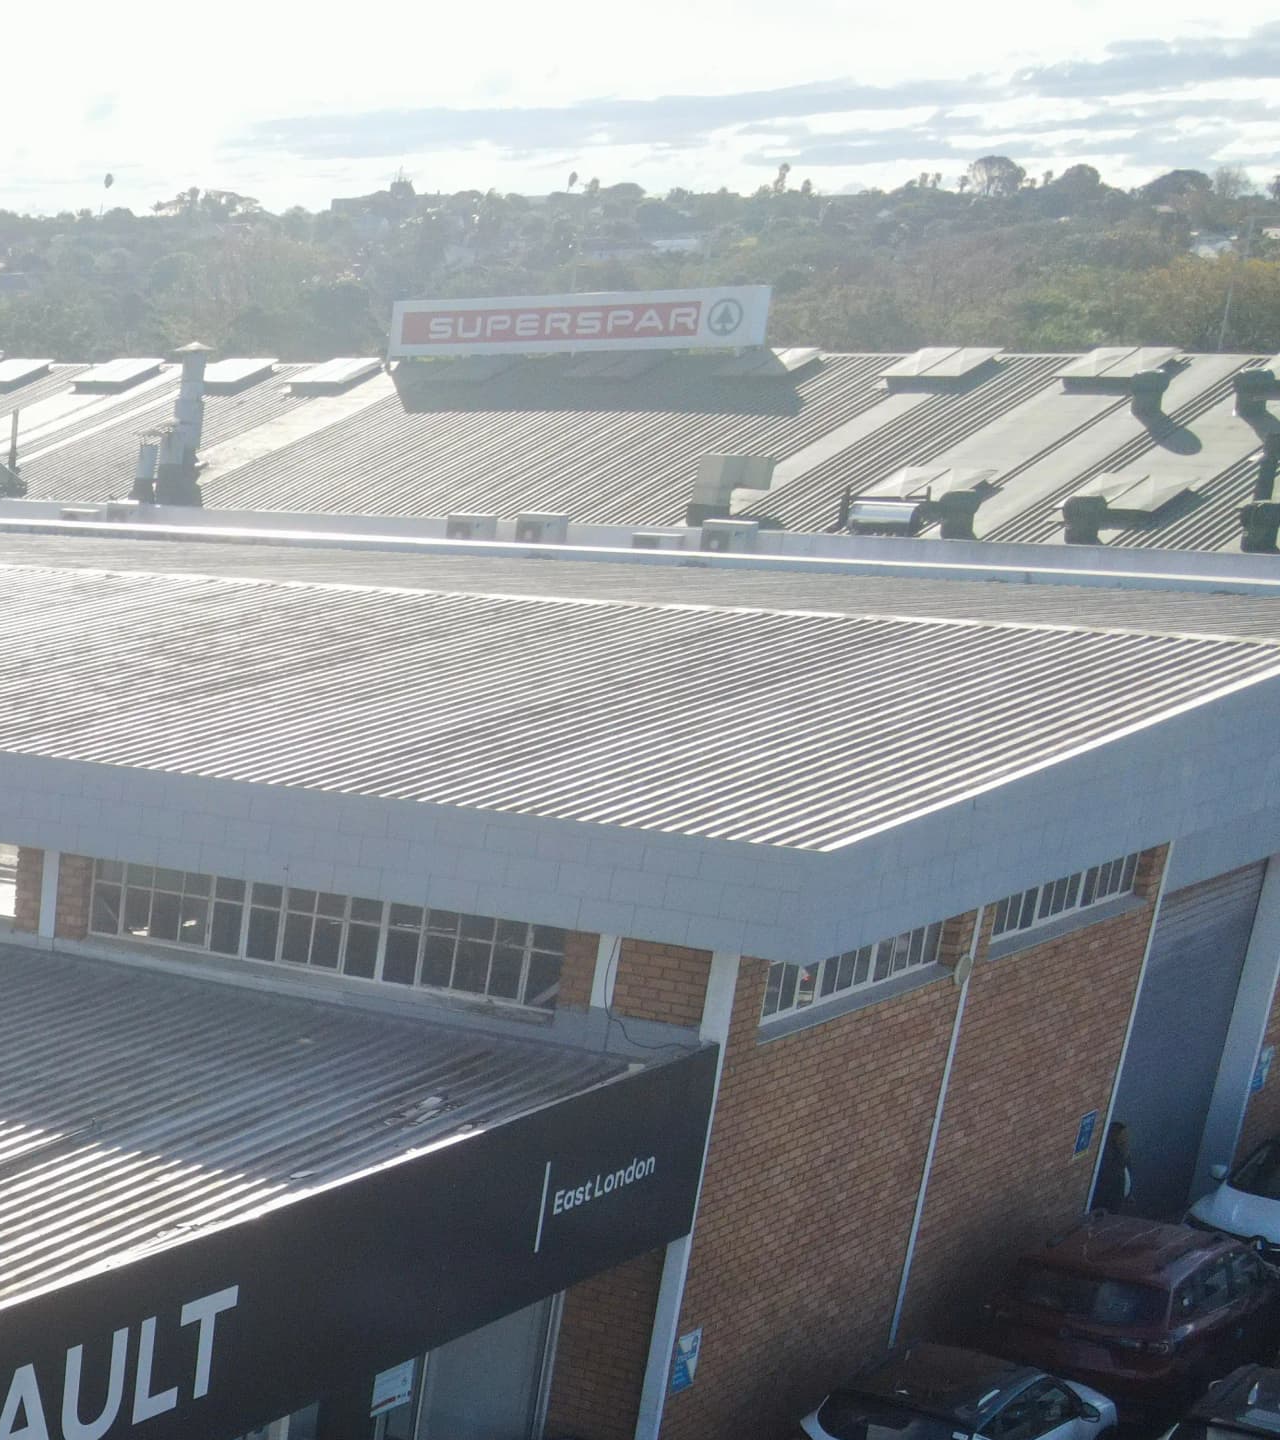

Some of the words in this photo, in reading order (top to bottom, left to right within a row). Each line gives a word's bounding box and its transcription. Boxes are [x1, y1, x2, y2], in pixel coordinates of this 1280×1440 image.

[428, 306, 699, 340] SUPERSPAR
[552, 1180, 592, 1215] East
[594, 1156, 656, 1198] London
